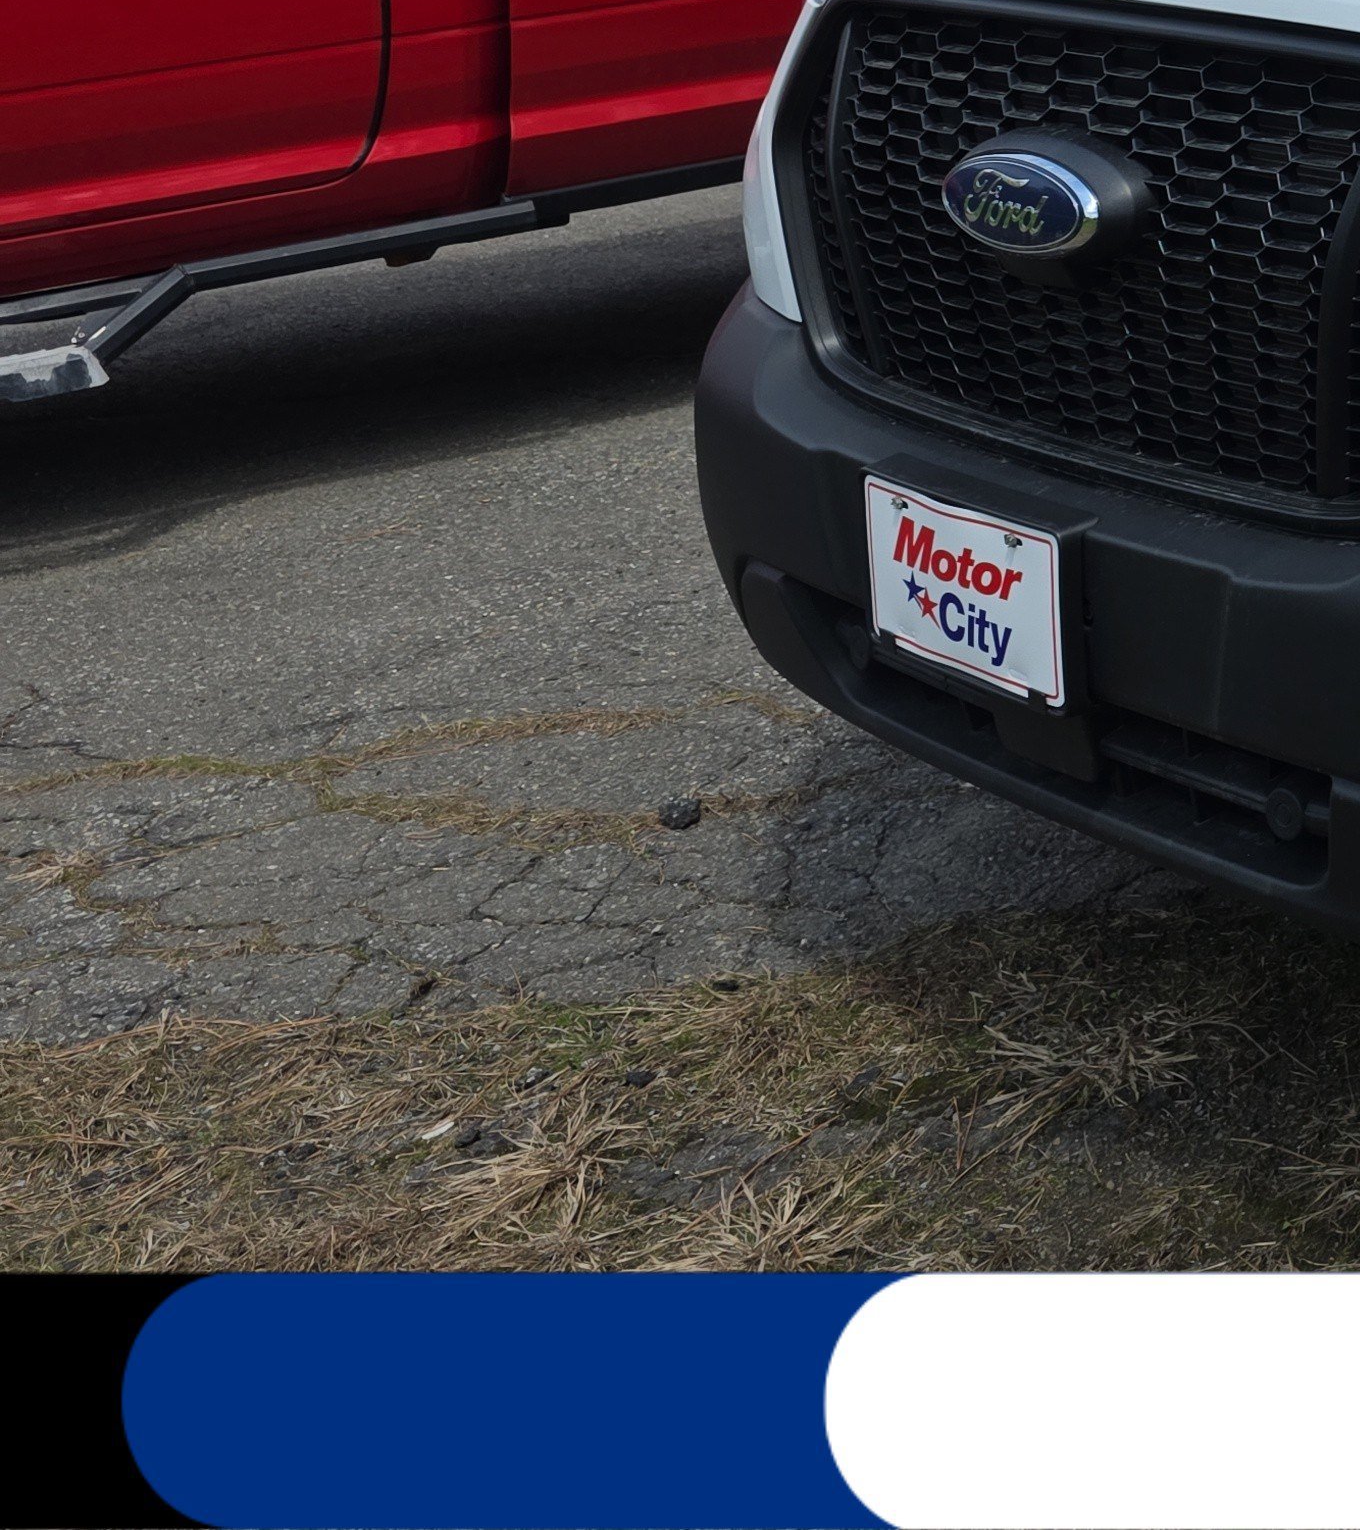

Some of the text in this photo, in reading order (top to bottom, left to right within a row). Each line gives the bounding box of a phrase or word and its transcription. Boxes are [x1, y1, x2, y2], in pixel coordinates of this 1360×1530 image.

[963, 168, 1050, 236] Ford
[893, 516, 1023, 601] Motor
[939, 592, 1013, 667] City
